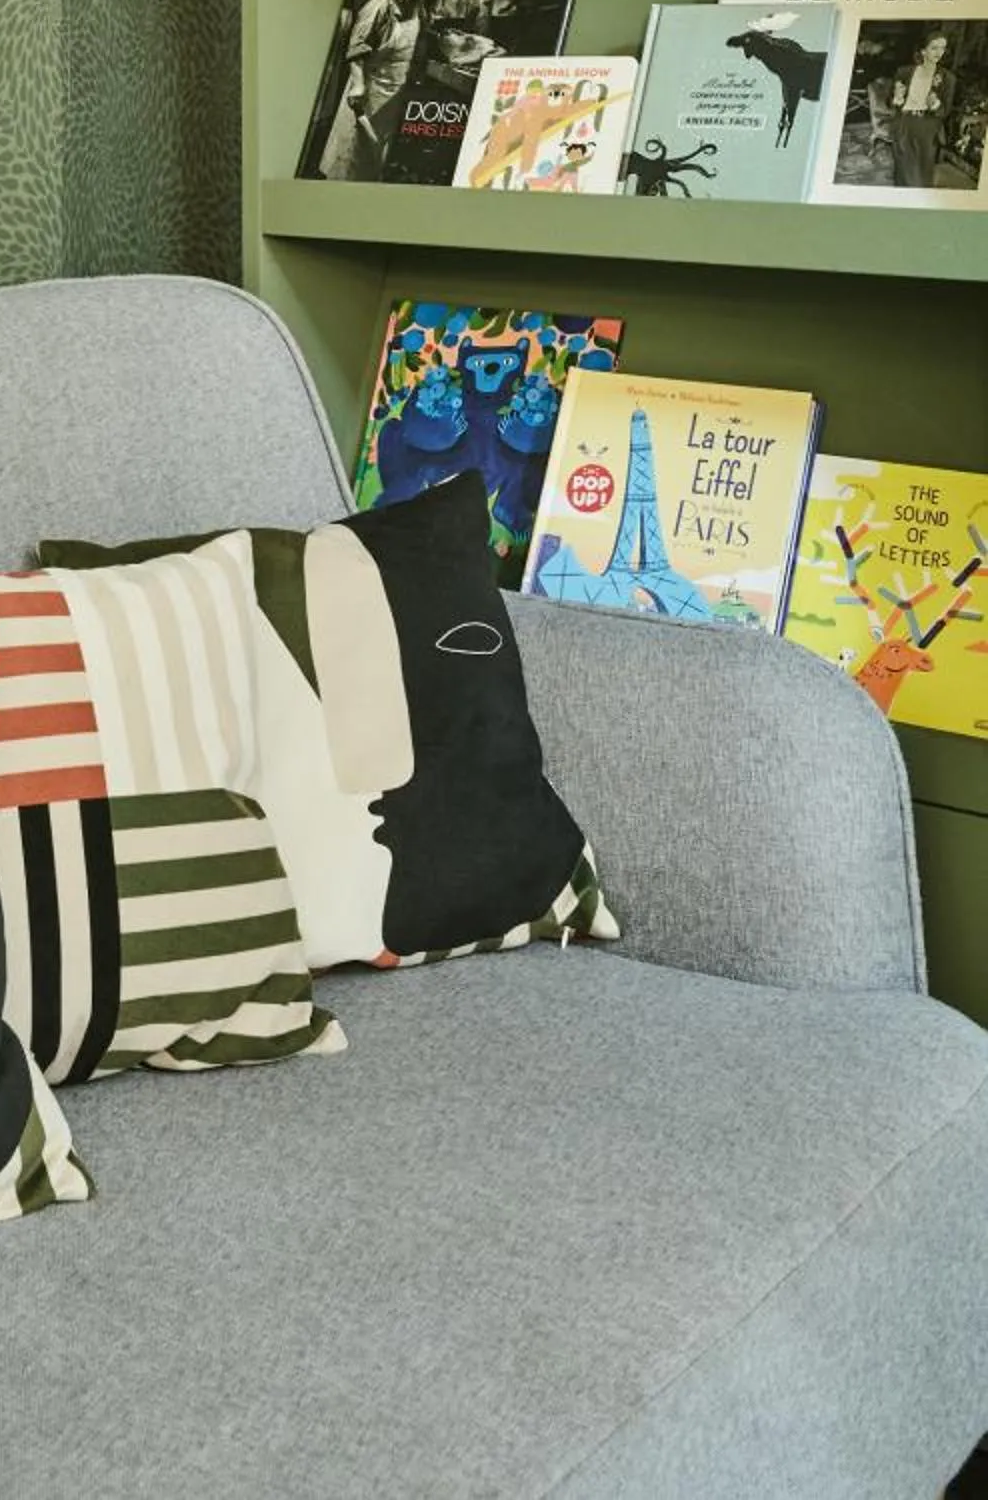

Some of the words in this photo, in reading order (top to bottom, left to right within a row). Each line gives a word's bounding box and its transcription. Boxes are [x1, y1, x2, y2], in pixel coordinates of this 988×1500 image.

[504, 68, 525, 77] THE
[527, 68, 570, 78] ANIMAL
[574, 68, 612, 77] SHOW
[401, 123, 437, 137] PARIS
[687, 412, 715, 449] La
[724, 429, 776, 456] tour
[572, 475, 612, 492] POP
[691, 458, 757, 501] Eiffel
[572, 490, 608, 507] UP!
[909, 484, 941, 505] THE
[672, 499, 754, 547] PARIS
[893, 504, 950, 528] SOUND
[906, 526, 929, 546] OF
[879, 540, 951, 569] LETTERS
